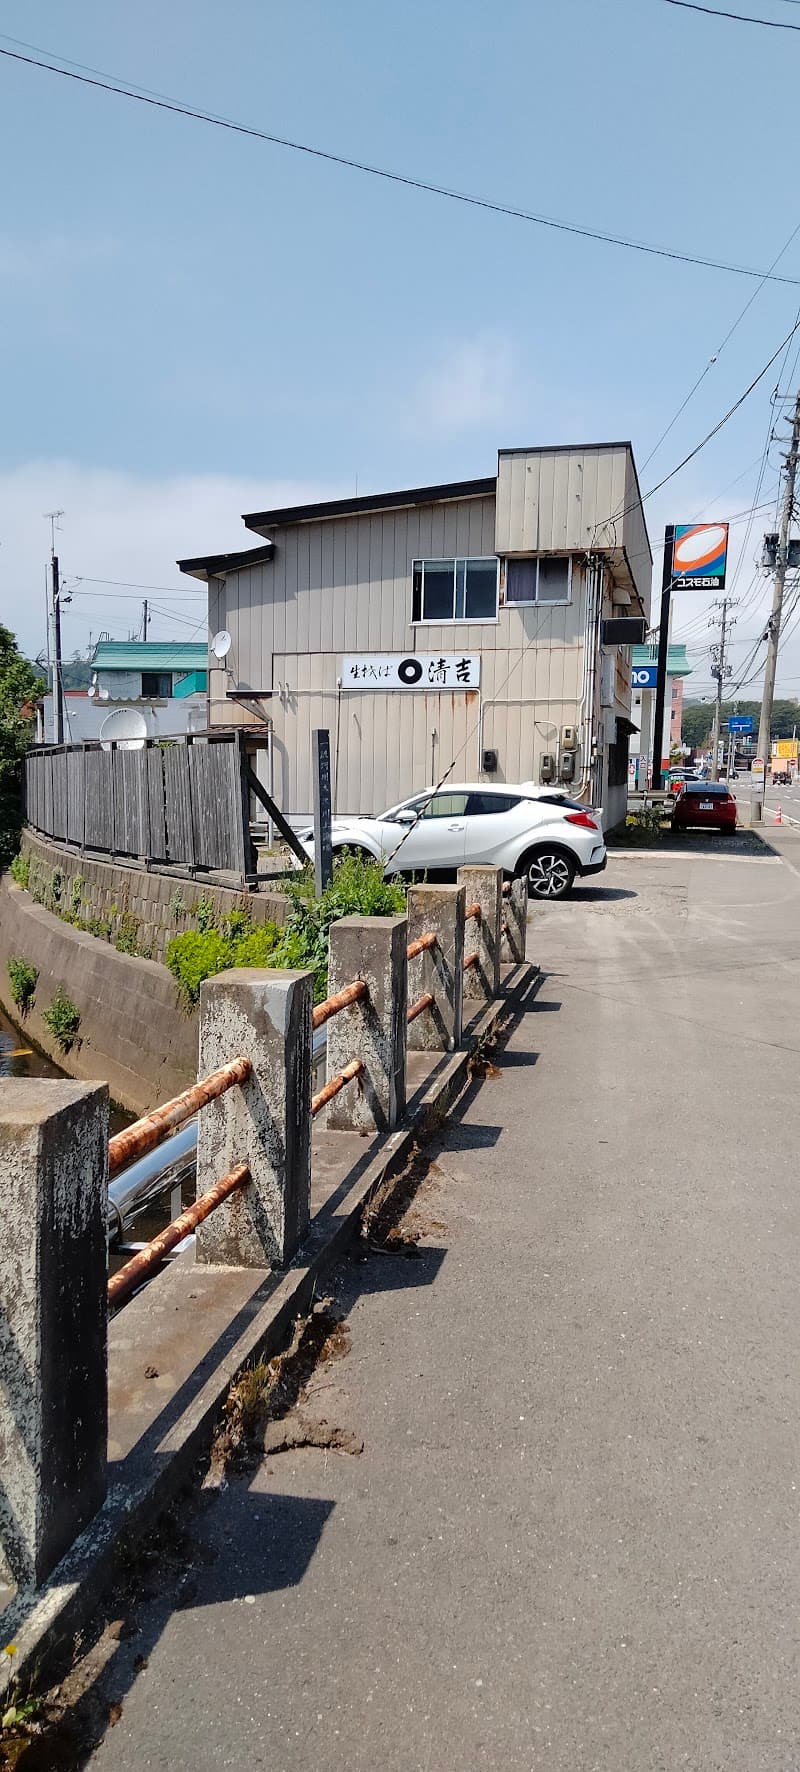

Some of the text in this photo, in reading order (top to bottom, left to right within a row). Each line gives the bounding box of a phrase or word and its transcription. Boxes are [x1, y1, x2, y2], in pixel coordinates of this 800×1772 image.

[677, 576, 720, 587] コスモ石油
[428, 657, 472, 684] 清吉
